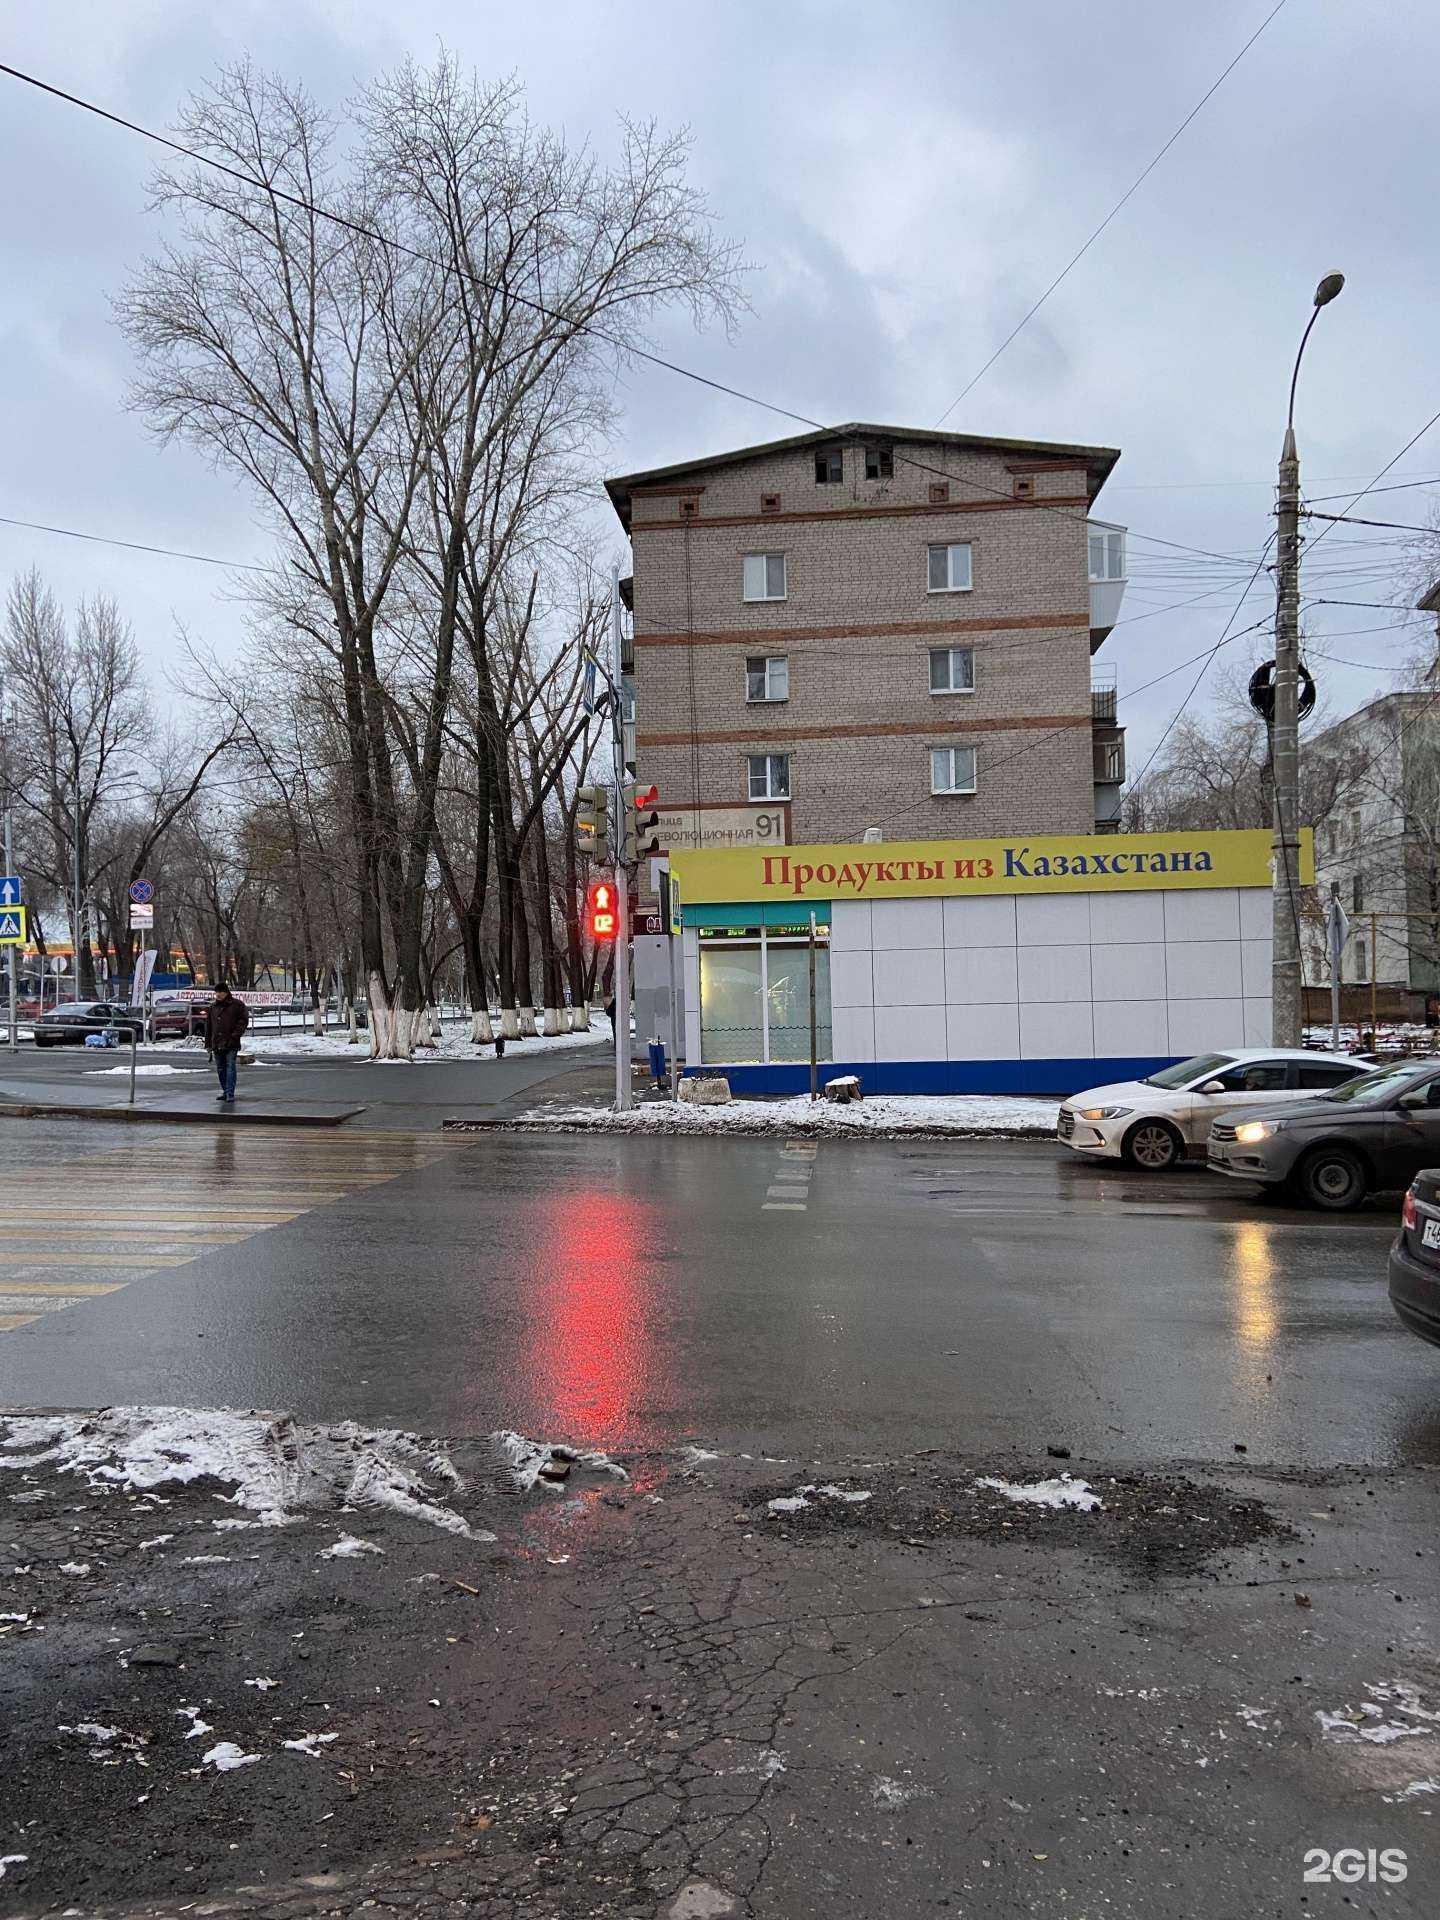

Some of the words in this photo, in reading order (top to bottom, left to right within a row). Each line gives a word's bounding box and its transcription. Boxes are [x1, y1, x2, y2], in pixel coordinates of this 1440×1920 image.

[657, 816, 683, 826] лица
[755, 814, 780, 838] 91
[761, 856, 945, 894] Продукты
[953, 857, 994, 879] из
[1002, 847, 1213, 878] Казахстана
